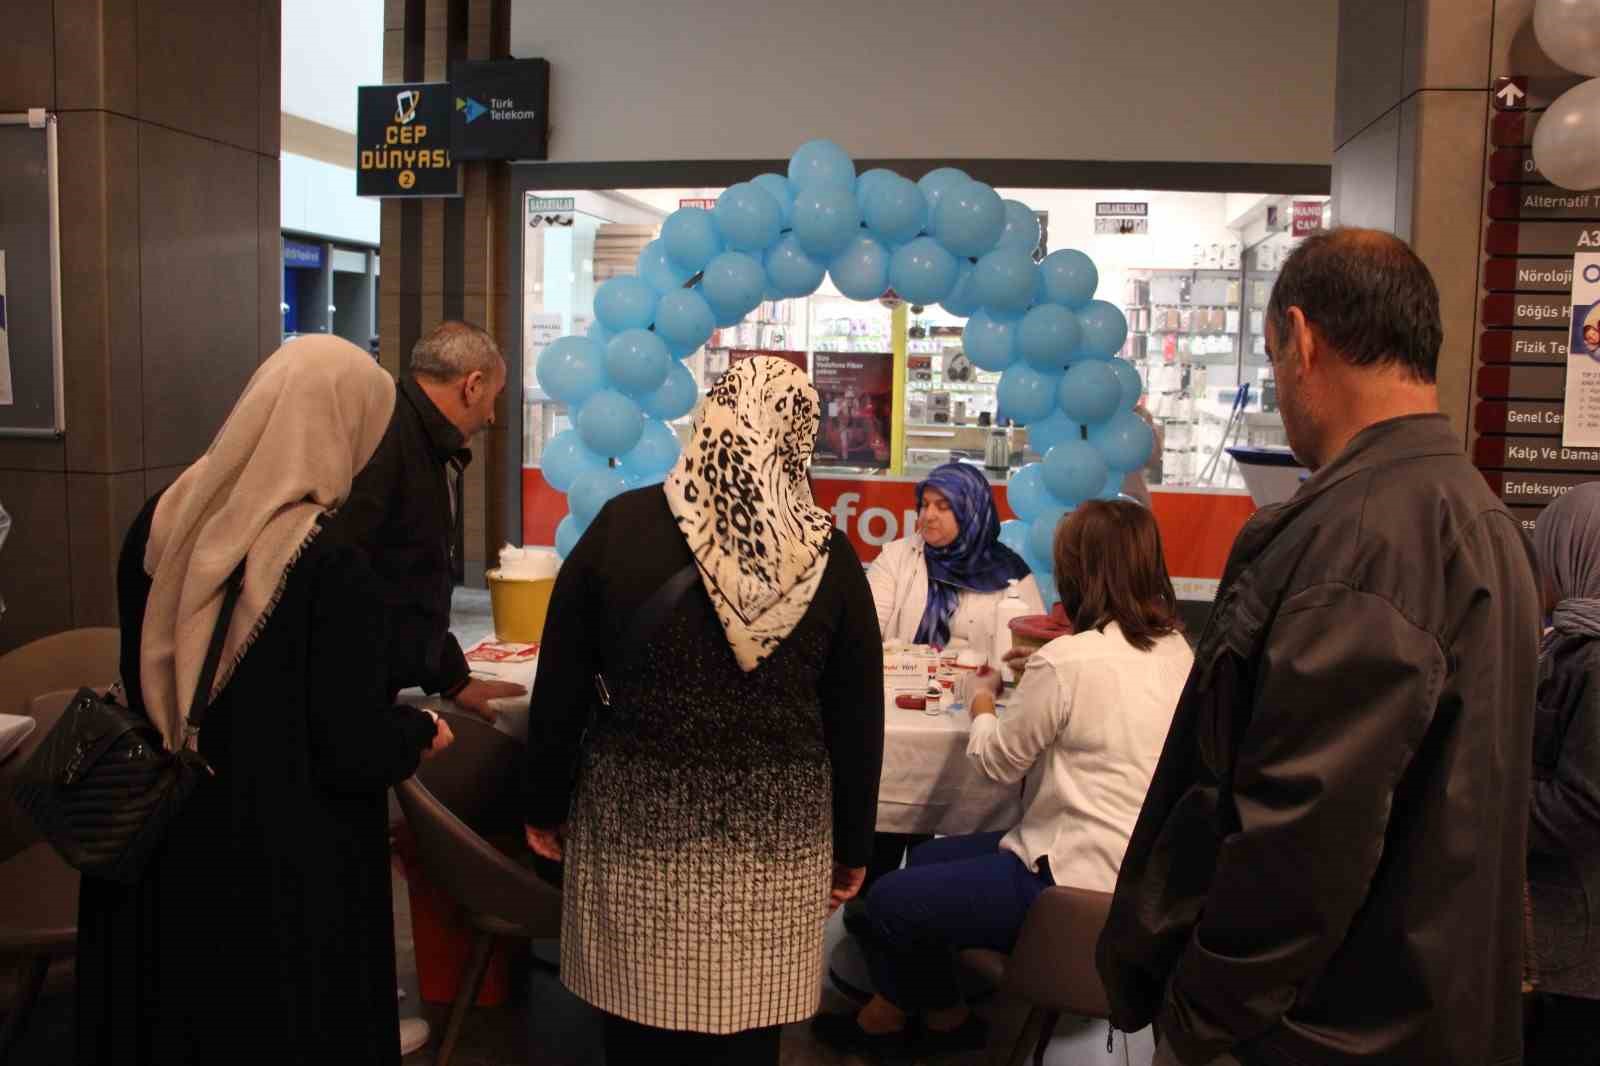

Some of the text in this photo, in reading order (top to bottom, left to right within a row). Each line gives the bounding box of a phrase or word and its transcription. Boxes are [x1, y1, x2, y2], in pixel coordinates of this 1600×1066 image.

[490, 97, 513, 109] Türk
[490, 109, 535, 121] Telekom
[386, 125, 427, 144] CEP
[1524, 193, 1589, 209] Alternatif
[1517, 304, 1559, 320] Göğüs
[1515, 341, 1546, 354] Fizik
[1508, 410, 1542, 423] Genel
[1508, 446, 1538, 461] Kalp
[1541, 447, 1558, 460] Ve
